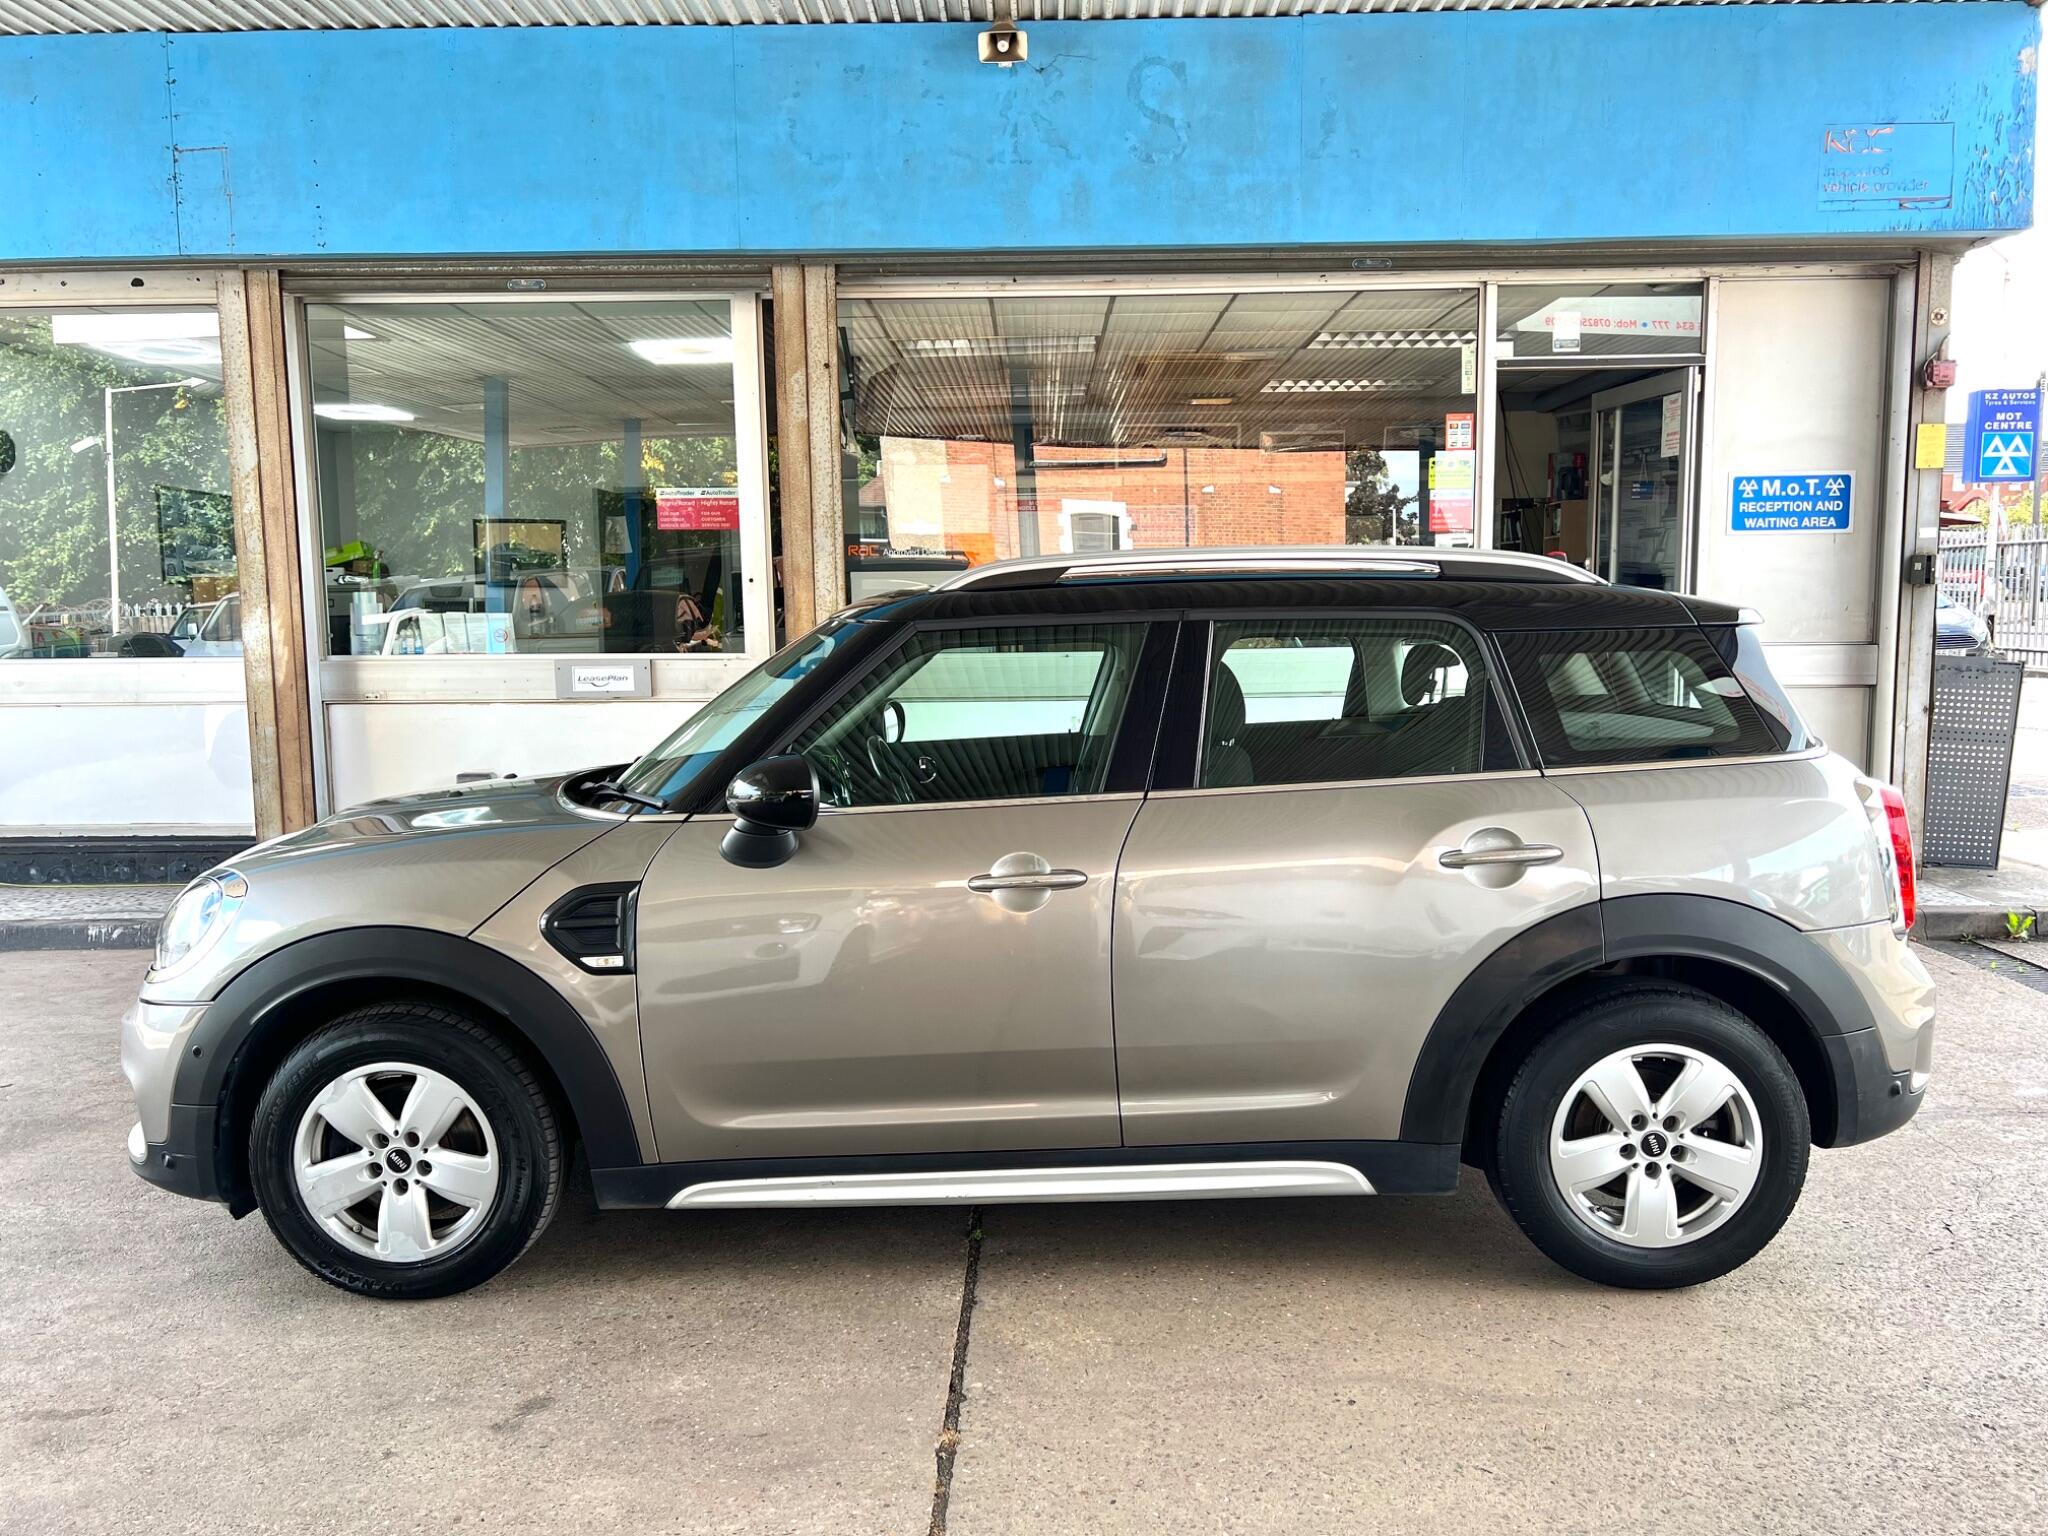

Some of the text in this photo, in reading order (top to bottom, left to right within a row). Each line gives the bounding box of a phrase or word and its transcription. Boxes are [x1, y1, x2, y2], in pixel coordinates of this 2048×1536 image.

[1984, 392, 2037, 400] KZ AUTOS
[1996, 412, 2022, 421] MOT
[1984, 421, 2033, 430] CENTRE
[1761, 478, 1822, 497] M.o.T.
[1739, 500, 1843, 513] RECEPTION AND
[1744, 516, 1837, 528] WAITING AREA
[577, 674, 629, 682] LeasePlan
[1648, 1134, 1661, 1155] MINI
[389, 1151, 408, 1170] MINI
